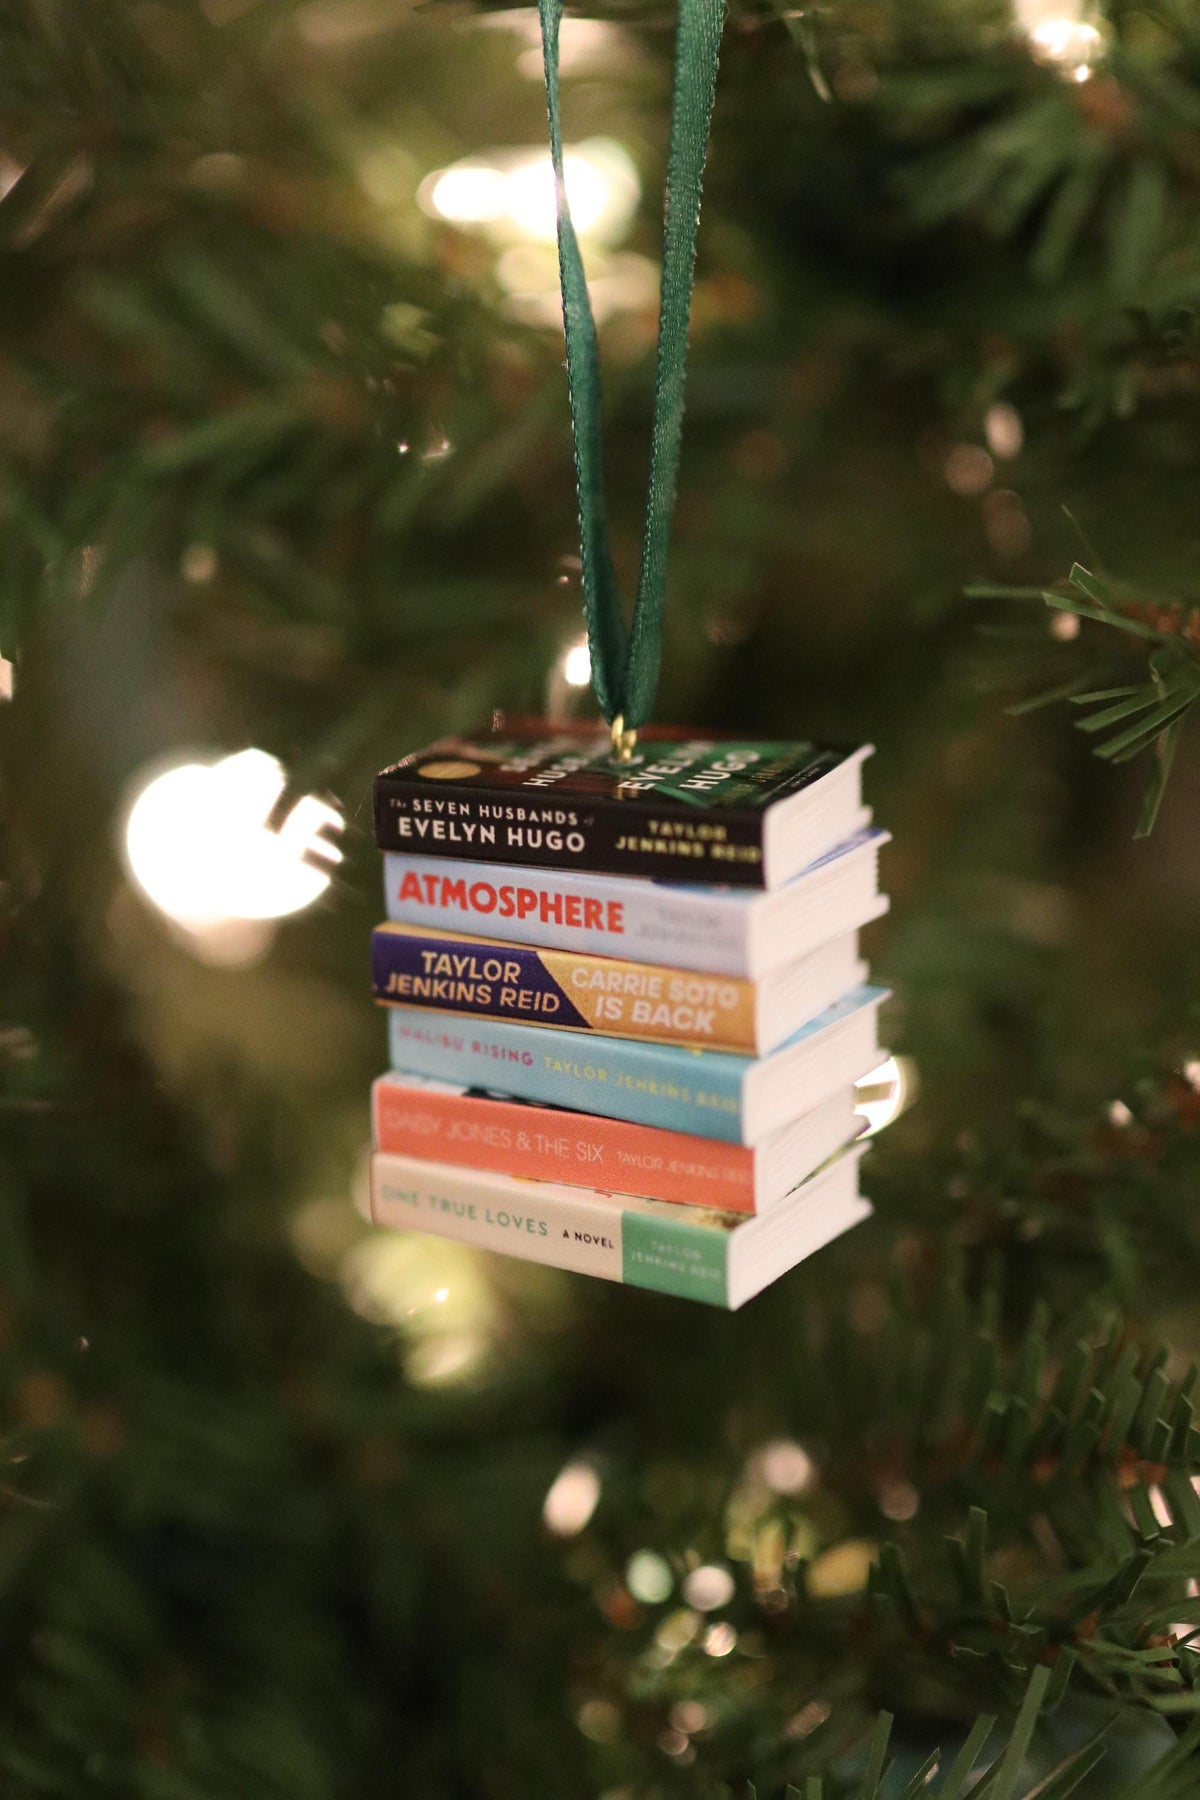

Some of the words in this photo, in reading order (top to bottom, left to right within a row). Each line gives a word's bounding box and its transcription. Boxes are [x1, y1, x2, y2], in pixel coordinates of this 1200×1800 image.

[413, 799, 470, 816] SEVEN
[479, 804, 579, 827] HUSBANDS
[648, 819, 728, 842] TAYLOR
[398, 816, 496, 845] EVELYN
[507, 826, 586, 853] HUGO
[615, 835, 704, 858] JENKINS
[710, 844, 762, 864] REID
[398, 870, 625, 934] ATMOSPHERE
[421, 951, 521, 985] TAYLOR
[385, 972, 492, 1005] JENKINS
[500, 986, 560, 1013] REID
[571, 967, 663, 999] CARRIE
[668, 978, 740, 1010] SOTO
[595, 994, 623, 1020] IS
[631, 1000, 717, 1034] BACK
[471, 1039, 534, 1066] RISING
[544, 1056, 608, 1082] TAYLOR
[617, 1073, 690, 1104] JENKINS
[447, 1121, 512, 1148] JONES
[515, 1131, 532, 1151] &
[534, 1133, 570, 1159] THE
[576, 1141, 604, 1163] SIX
[616, 1151, 663, 1170] TAYLOR
[429, 1194, 479, 1220] TRUE
[485, 1208, 548, 1237] LOVES
[563, 1228, 570, 1239] A
[574, 1231, 615, 1250] NOVEL
